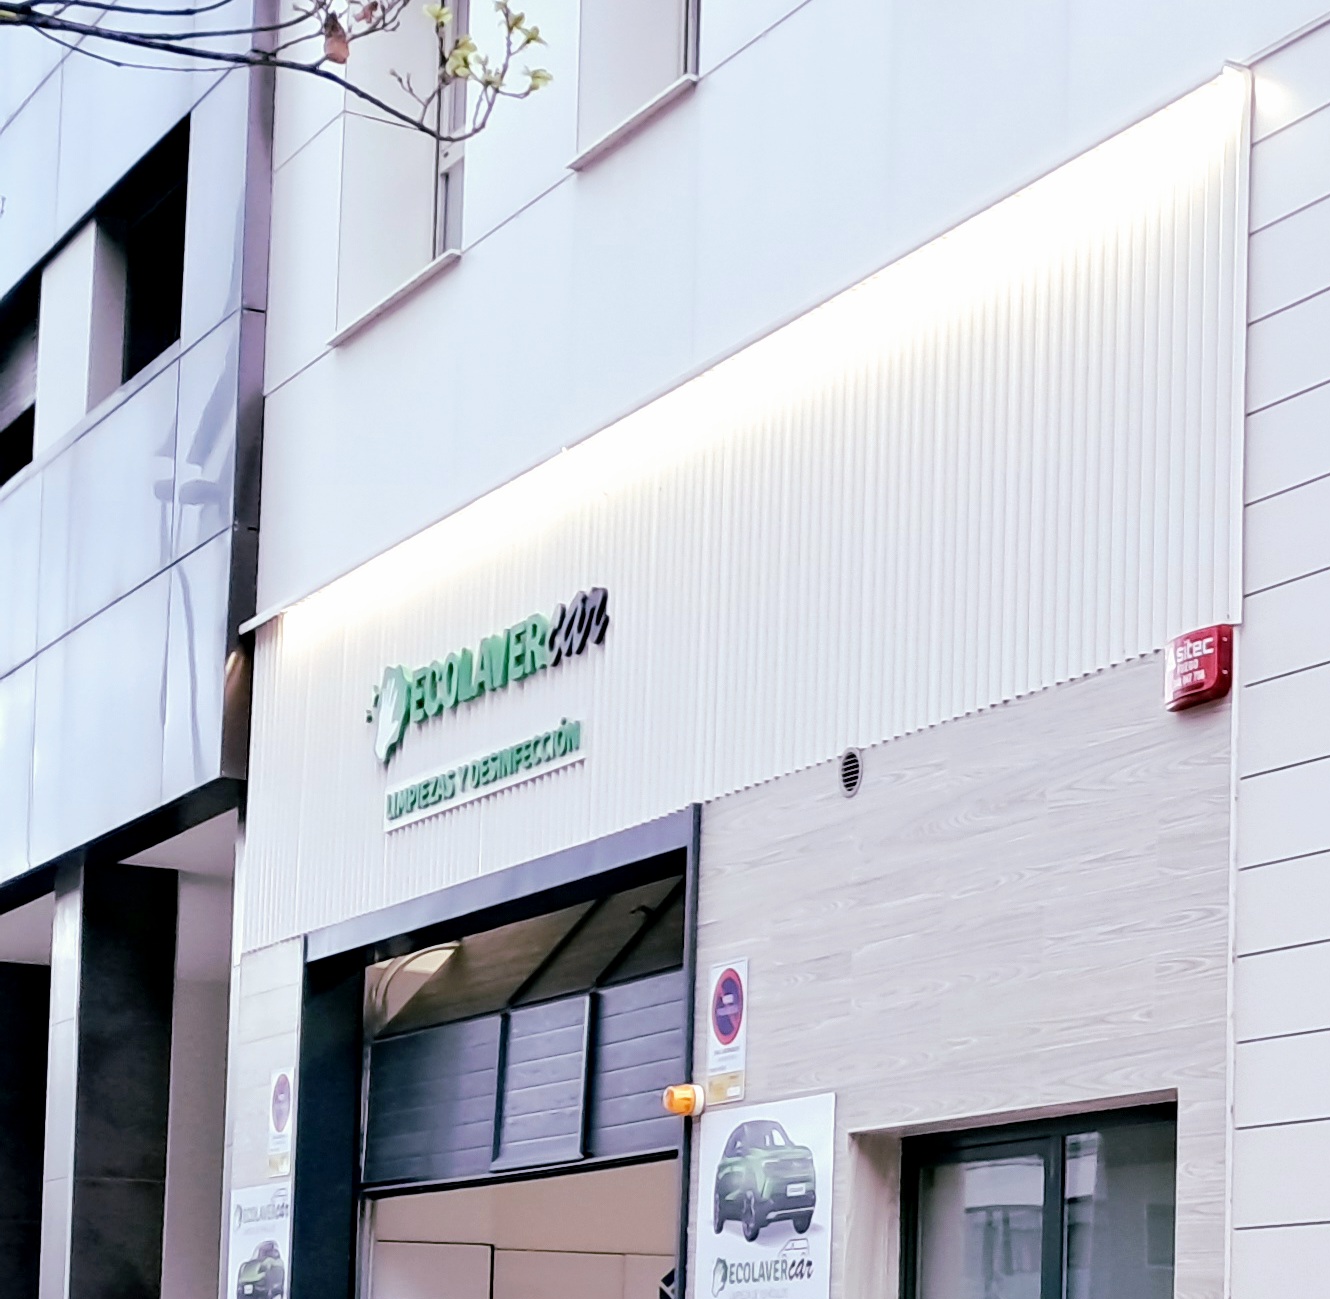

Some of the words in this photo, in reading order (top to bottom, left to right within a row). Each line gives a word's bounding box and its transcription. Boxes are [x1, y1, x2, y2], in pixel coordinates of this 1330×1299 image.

[386, 769, 456, 820] LIMPIEZAS
[457, 764, 470, 794] Y
[469, 717, 581, 790] DESINFECCIÓN
